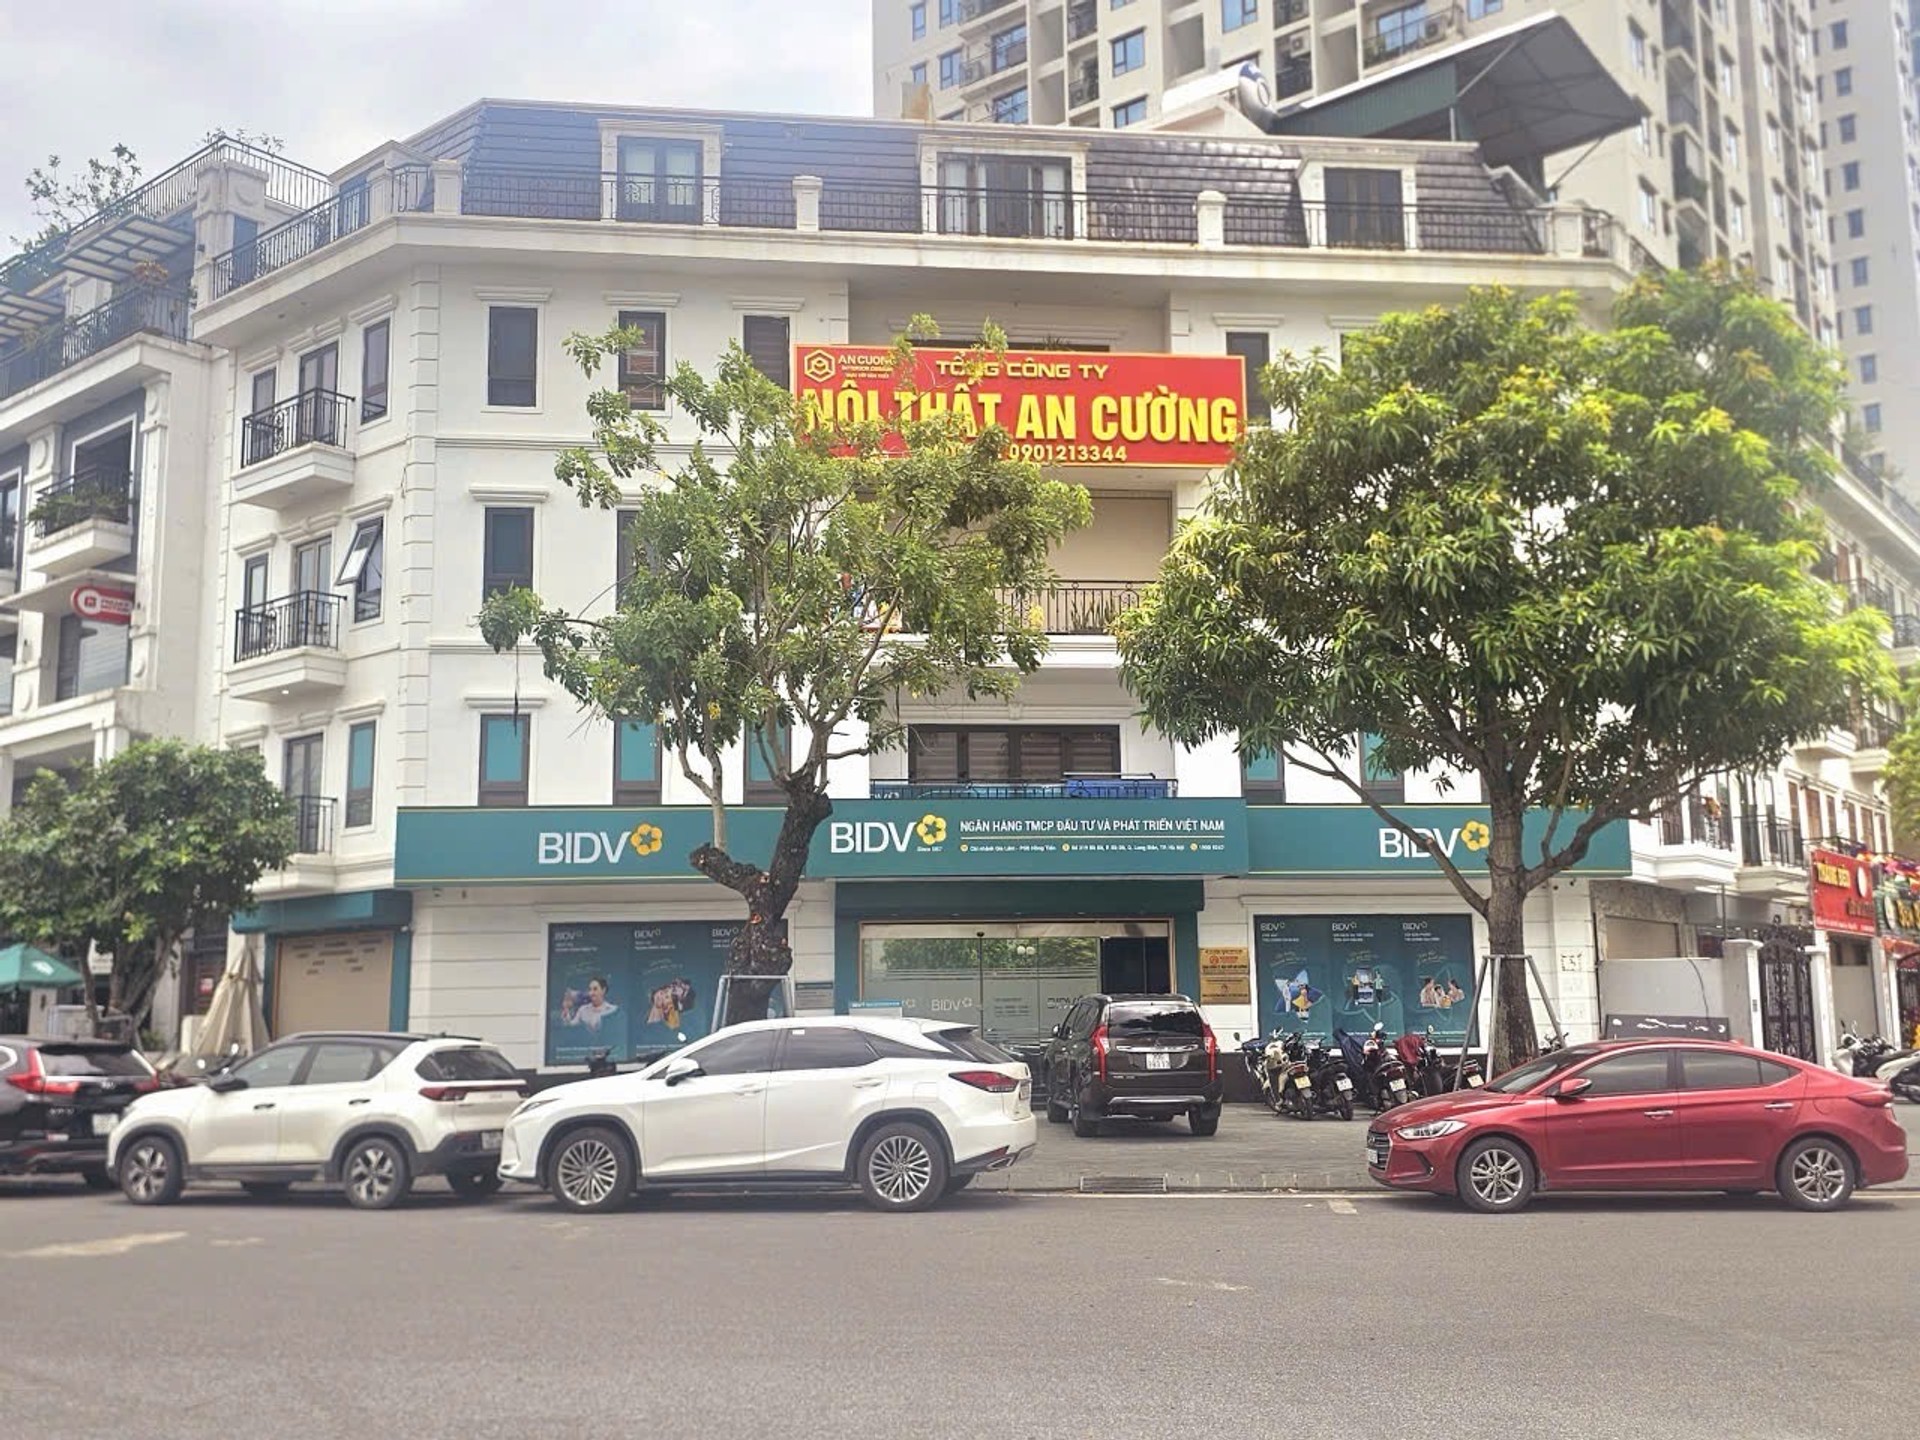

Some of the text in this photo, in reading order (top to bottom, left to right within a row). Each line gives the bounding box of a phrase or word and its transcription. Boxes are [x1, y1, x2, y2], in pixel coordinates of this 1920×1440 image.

[936, 351, 1108, 379] TỔG CÔNG TY
[1015, 394, 1076, 440] AN
[1091, 384, 1238, 443] CƯỜNG
[1009, 443, 1128, 462] 0901213344
[831, 822, 917, 853] BIDV
[960, 817, 1225, 832] NGÂN HÀNG TMCP ĐẦU TƯ VÀ PHÁT TRIỂN VIỆT NAM
[538, 831, 632, 864] BIDV
[1378, 828, 1462, 858] BIDV
[931, 999, 961, 1011] BIDV
